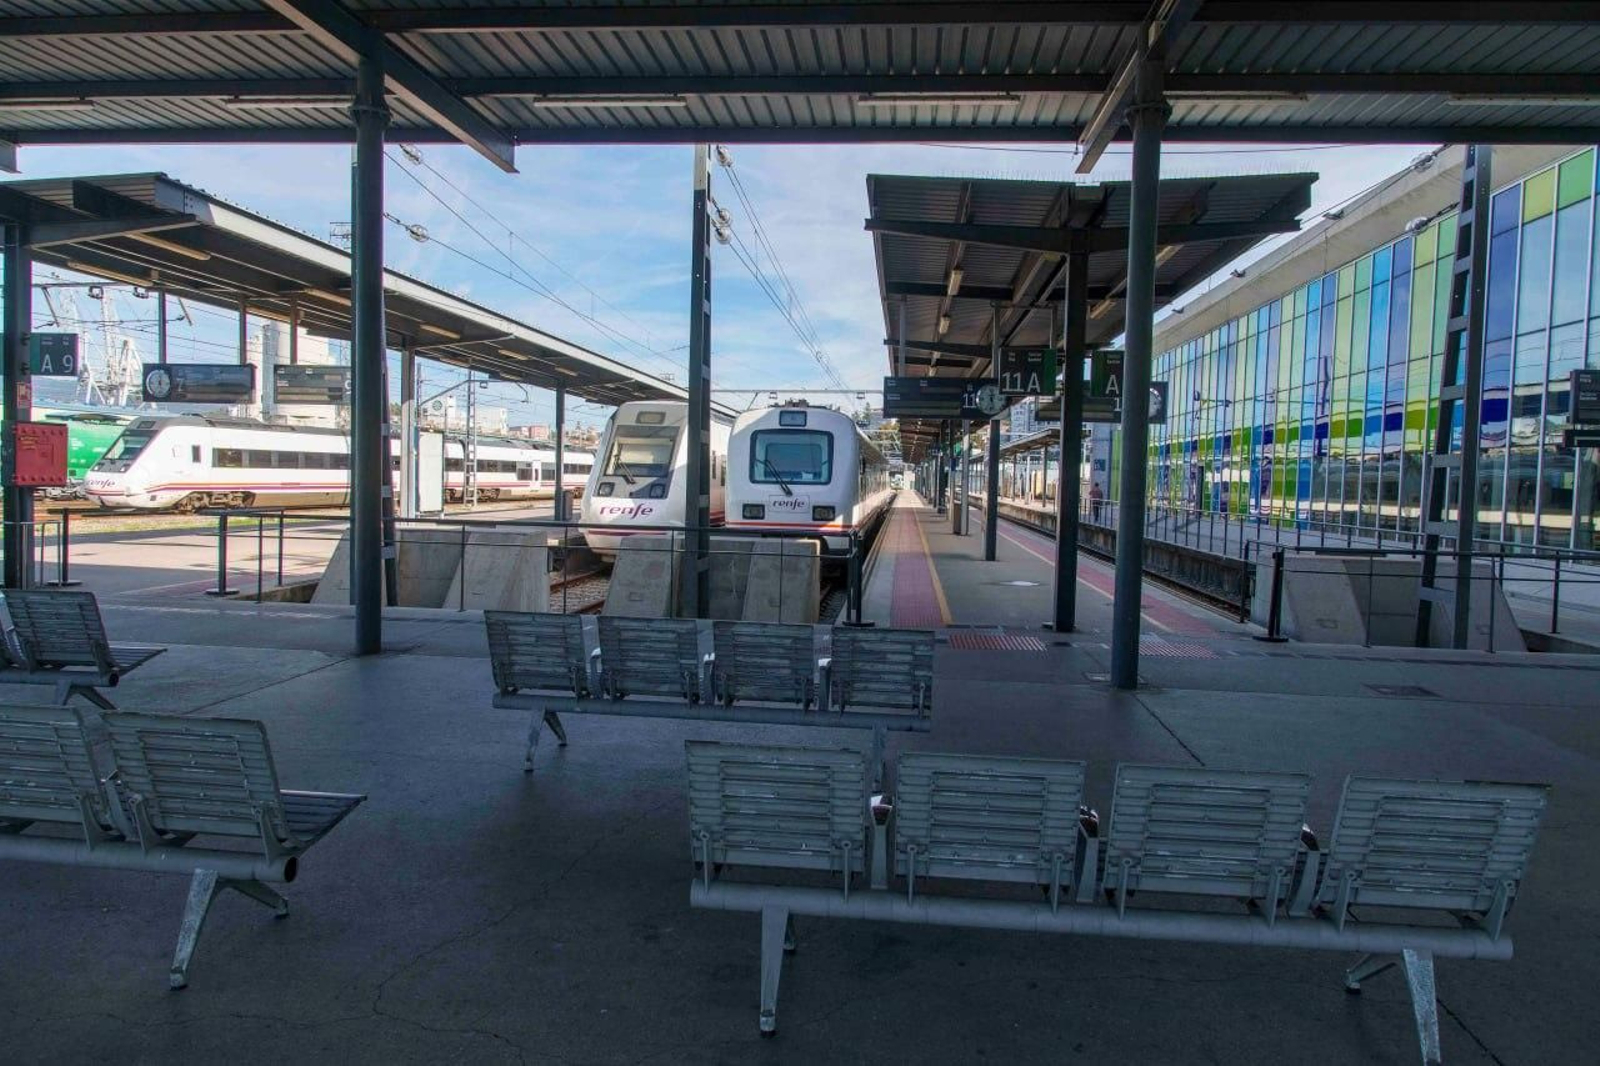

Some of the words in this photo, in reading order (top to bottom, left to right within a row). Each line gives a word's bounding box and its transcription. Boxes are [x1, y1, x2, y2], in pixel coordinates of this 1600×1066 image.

[41, 353, 53, 373] A
[62, 354, 74, 373] 9
[1105, 374, 1119, 394] A
[963, 392, 977, 408] 11
[599, 502, 653, 520] renfe
[772, 497, 805, 511] renfe
